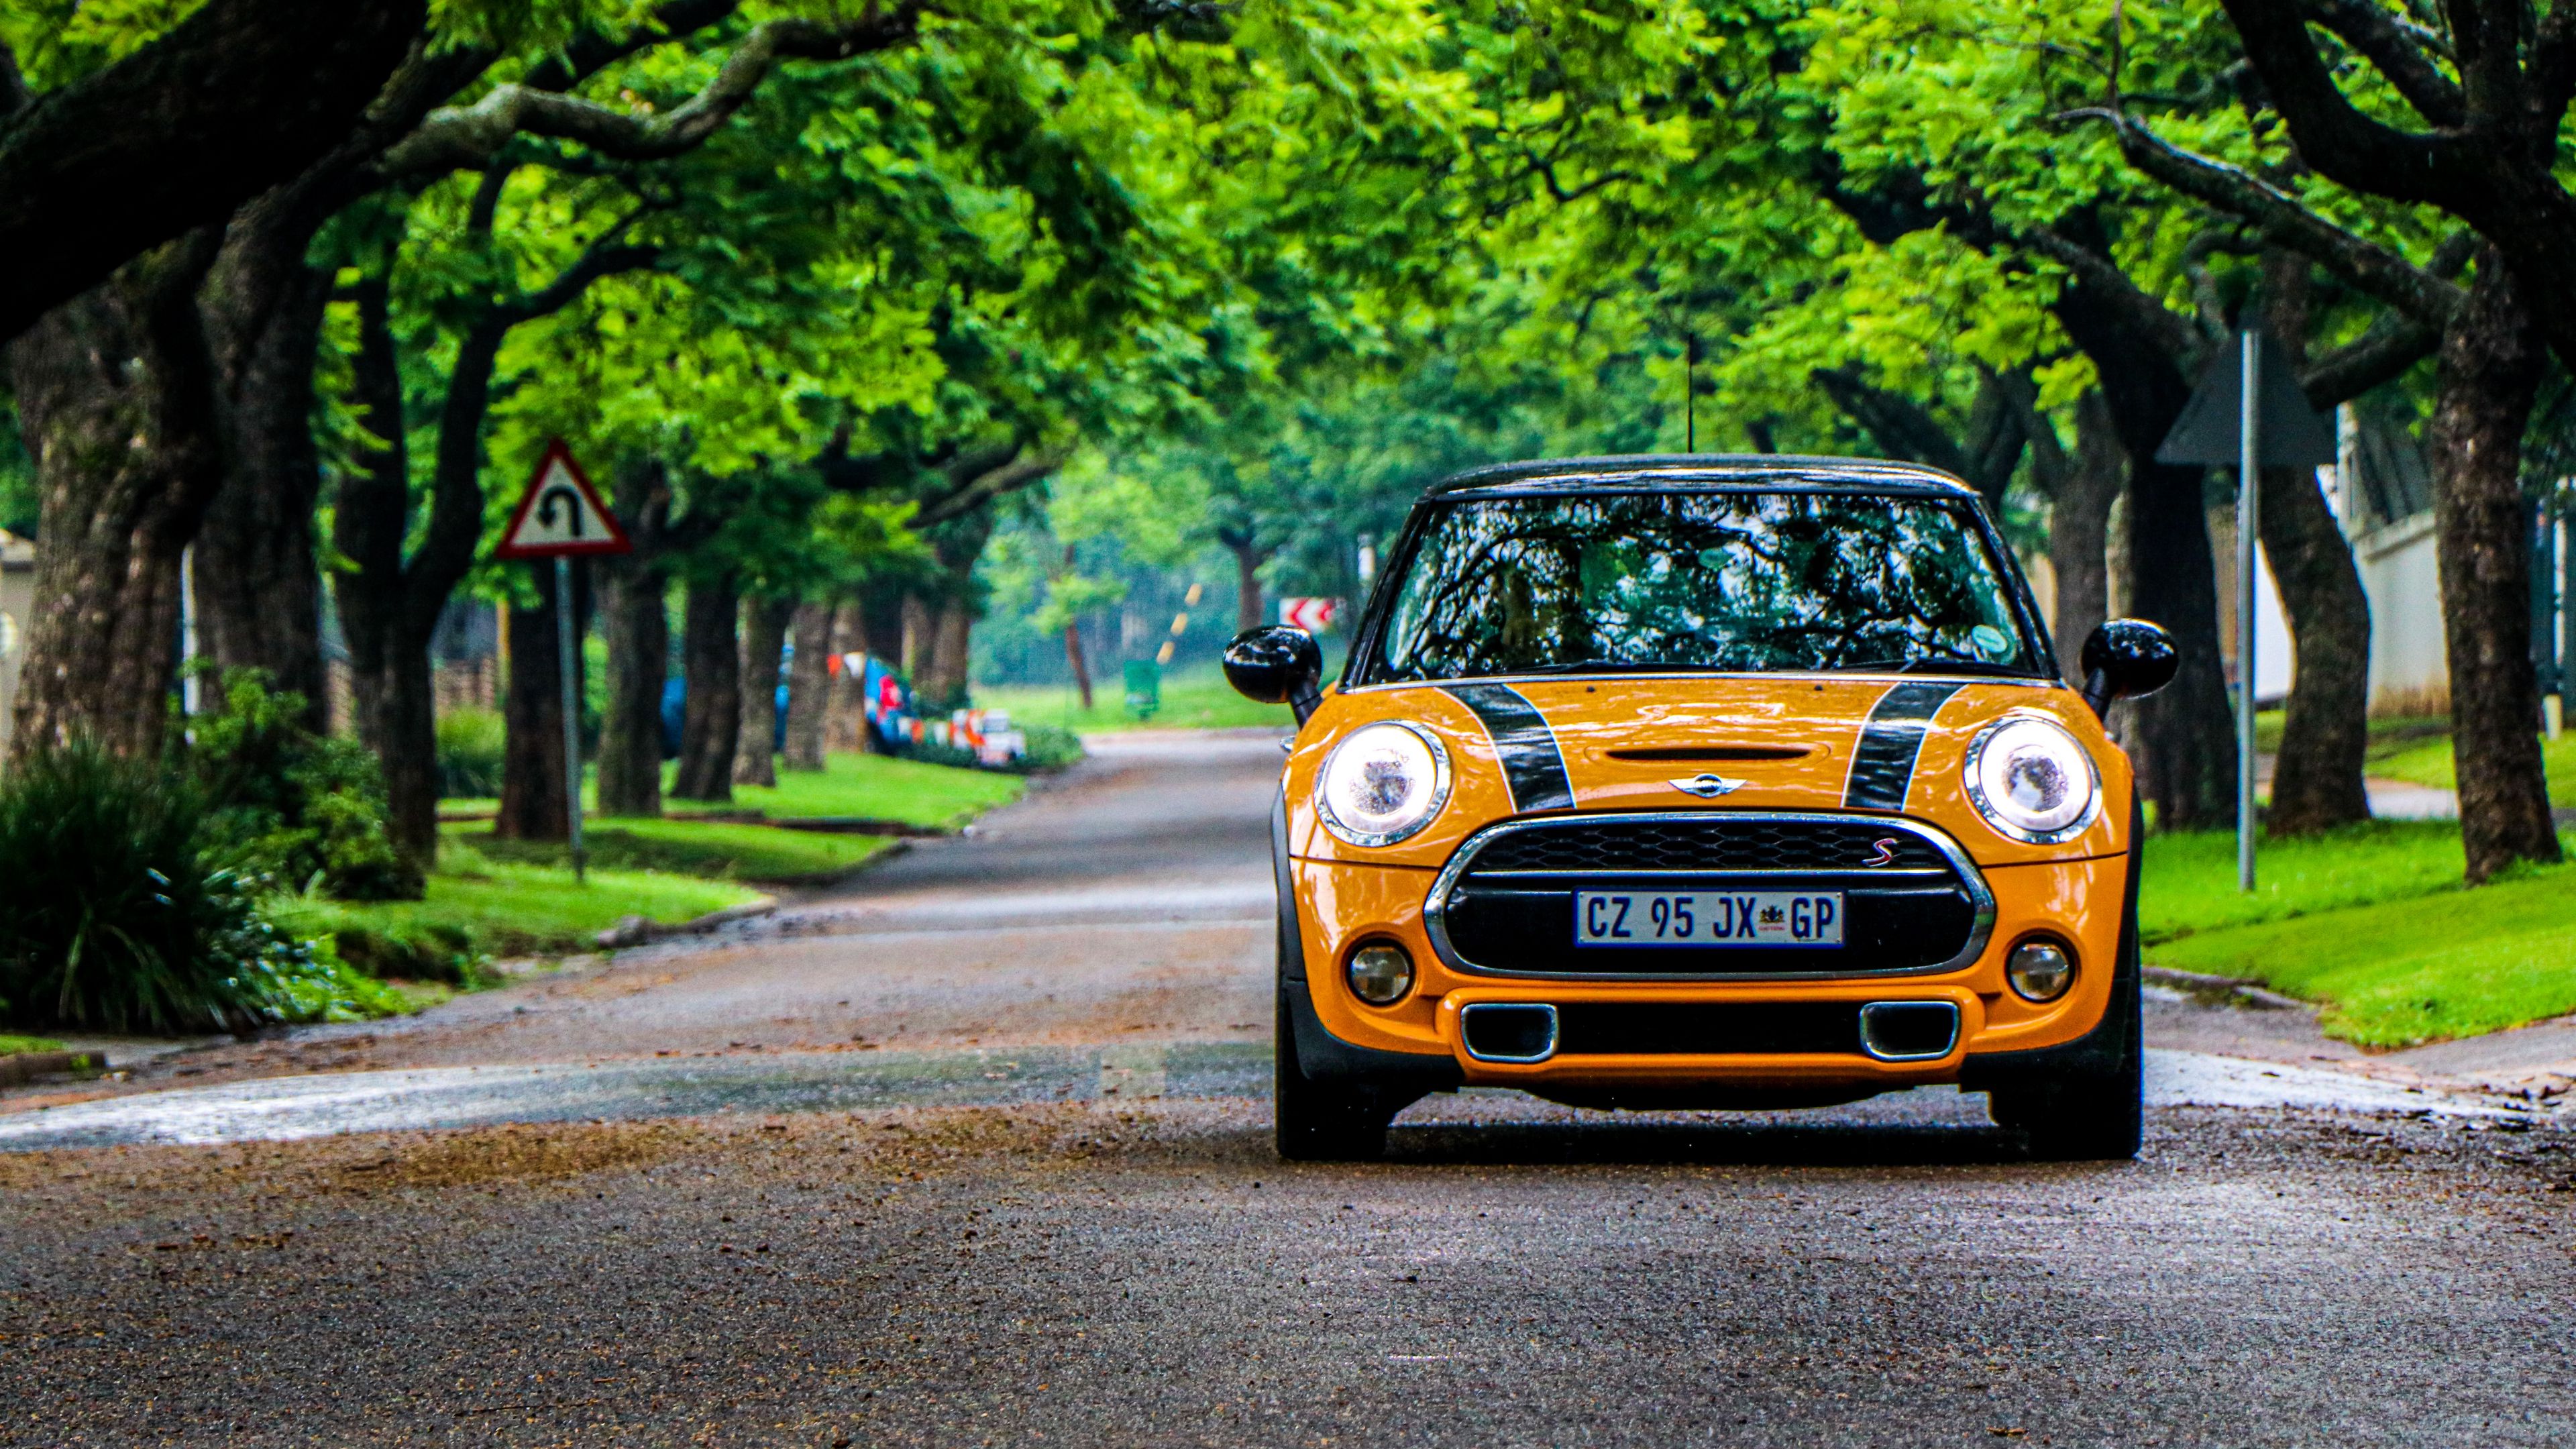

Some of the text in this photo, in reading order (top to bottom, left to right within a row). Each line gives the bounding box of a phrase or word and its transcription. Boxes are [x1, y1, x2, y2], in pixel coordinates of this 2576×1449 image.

[1862, 838, 1898, 867] S
[1587, 897, 1835, 938] CZ 95 JX GP
